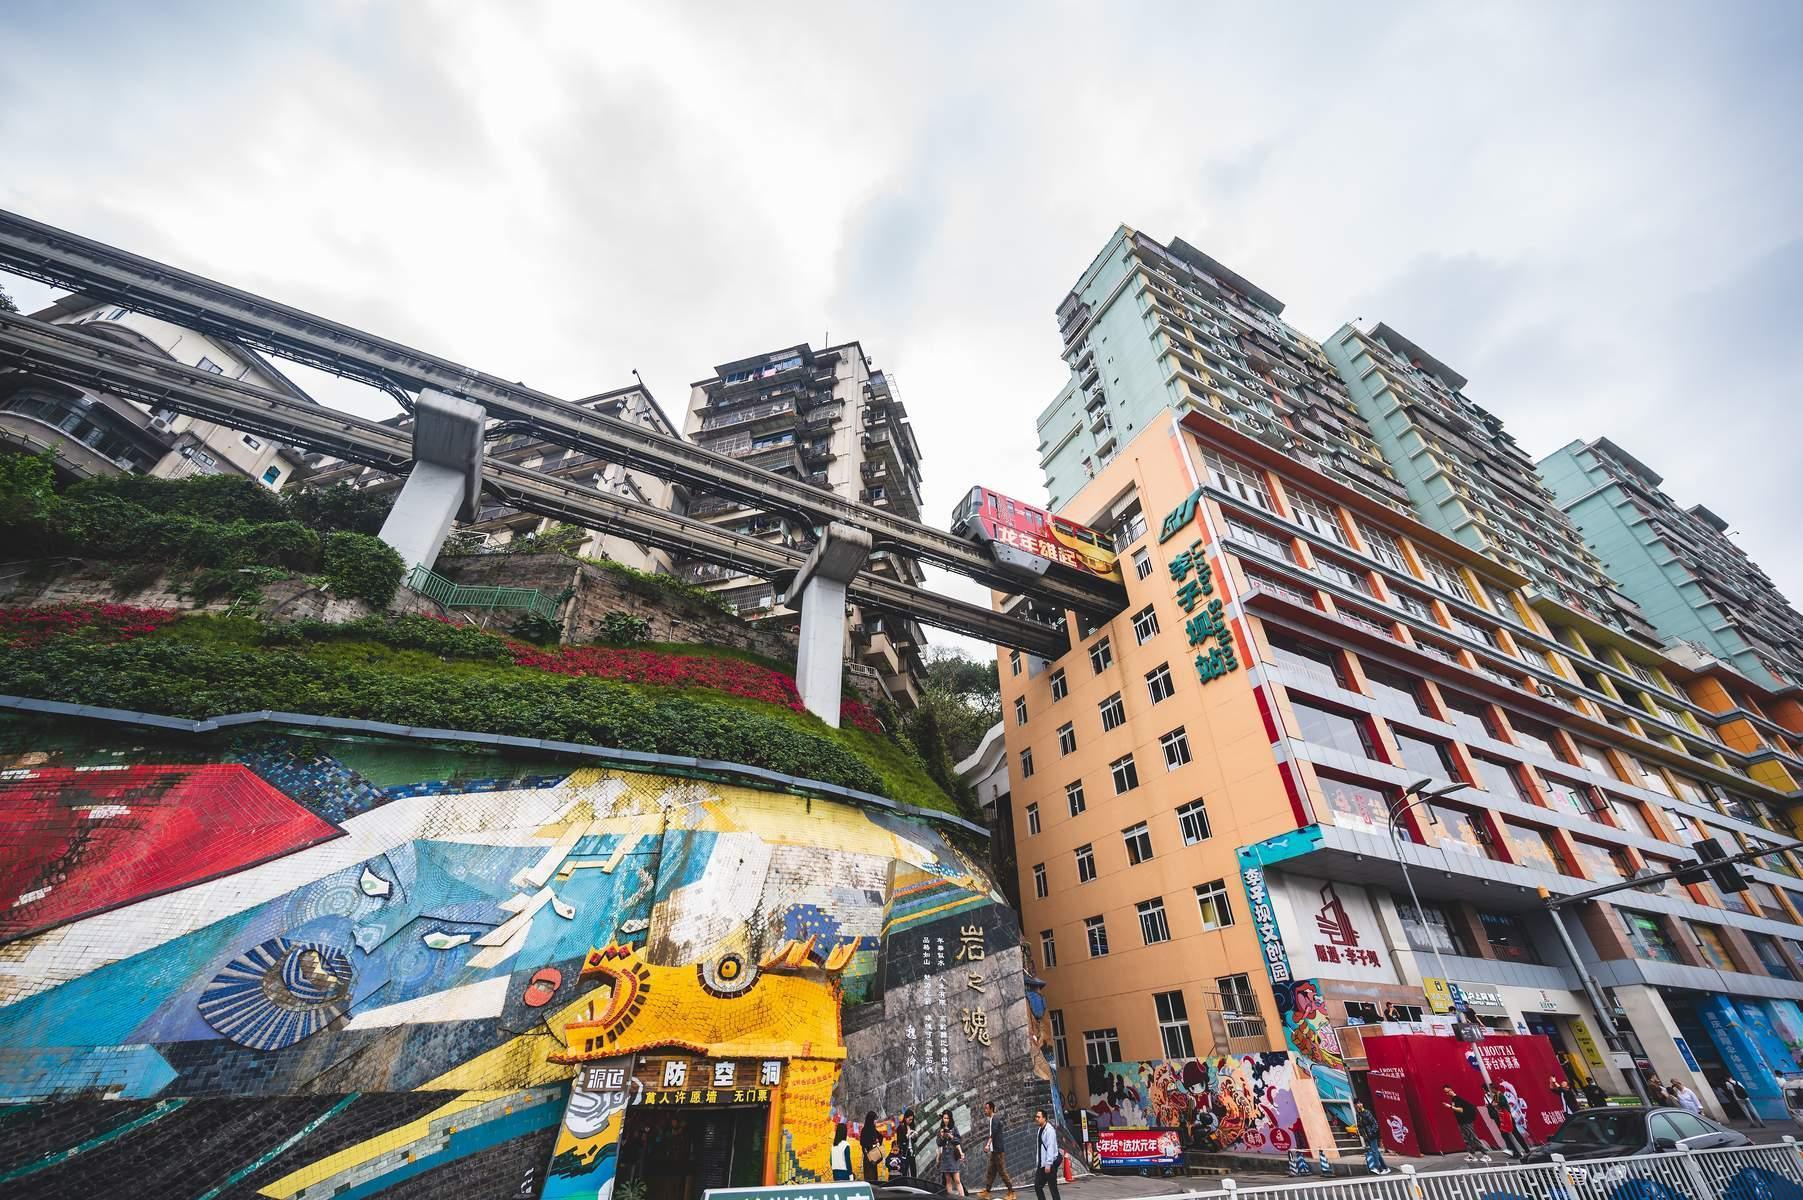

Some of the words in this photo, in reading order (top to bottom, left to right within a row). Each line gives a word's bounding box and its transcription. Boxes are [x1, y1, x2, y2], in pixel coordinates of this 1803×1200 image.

[998, 526, 1078, 568] 龙年雄起
[1168, 549, 1228, 685] 李子坝站
[1190, 538, 1214, 596] Liziba
[1207, 598, 1239, 673] Station
[1244, 868, 1289, 983] 李子坝文创园
[956, 924, 992, 1047] 岩之魂
[645, 1091, 718, 1105] 萬人许愿墙
[734, 1089, 769, 1103] 无门票
[663, 1061, 781, 1087] 防空洞
